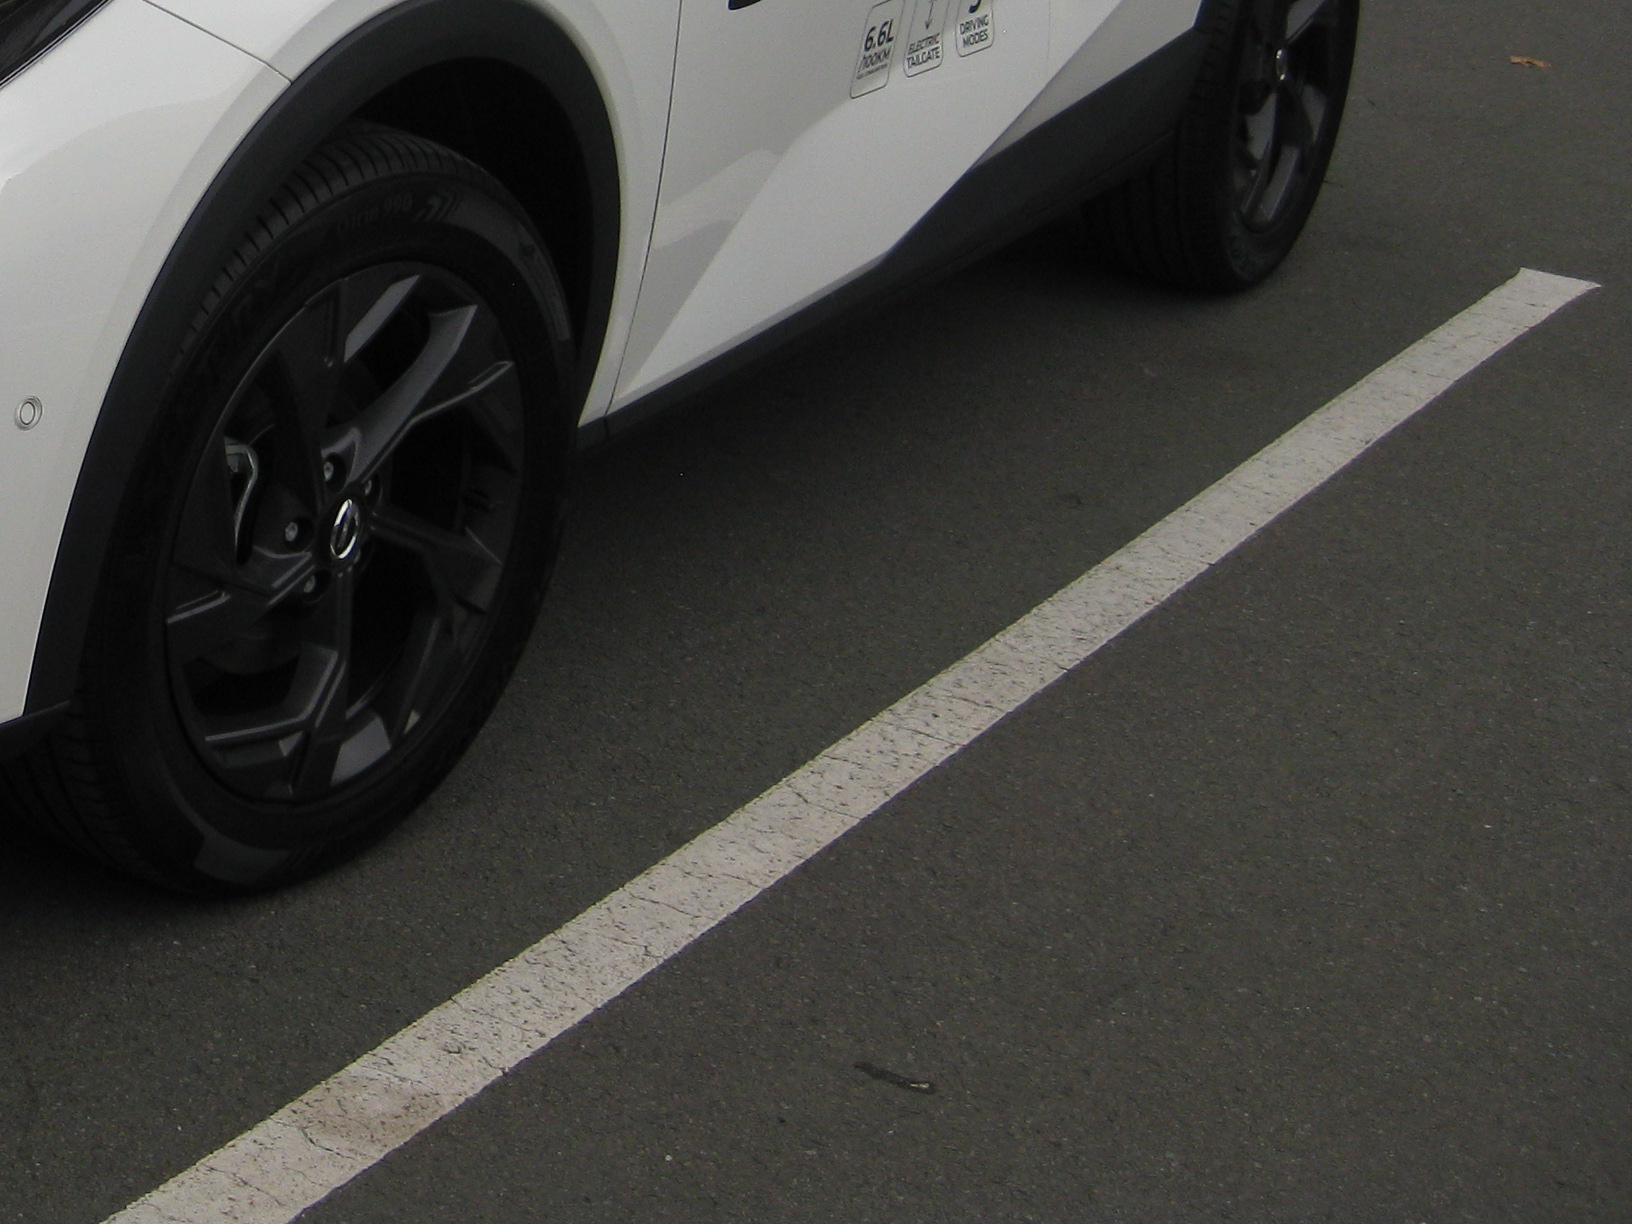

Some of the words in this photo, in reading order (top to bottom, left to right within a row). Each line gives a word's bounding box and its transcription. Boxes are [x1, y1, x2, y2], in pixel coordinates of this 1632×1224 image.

[863, 19, 895, 53] 6.6L
[959, 14, 990, 36] DRIVING
[962, 28, 989, 49] MODES
[906, 46, 941, 70] TAILGATE
